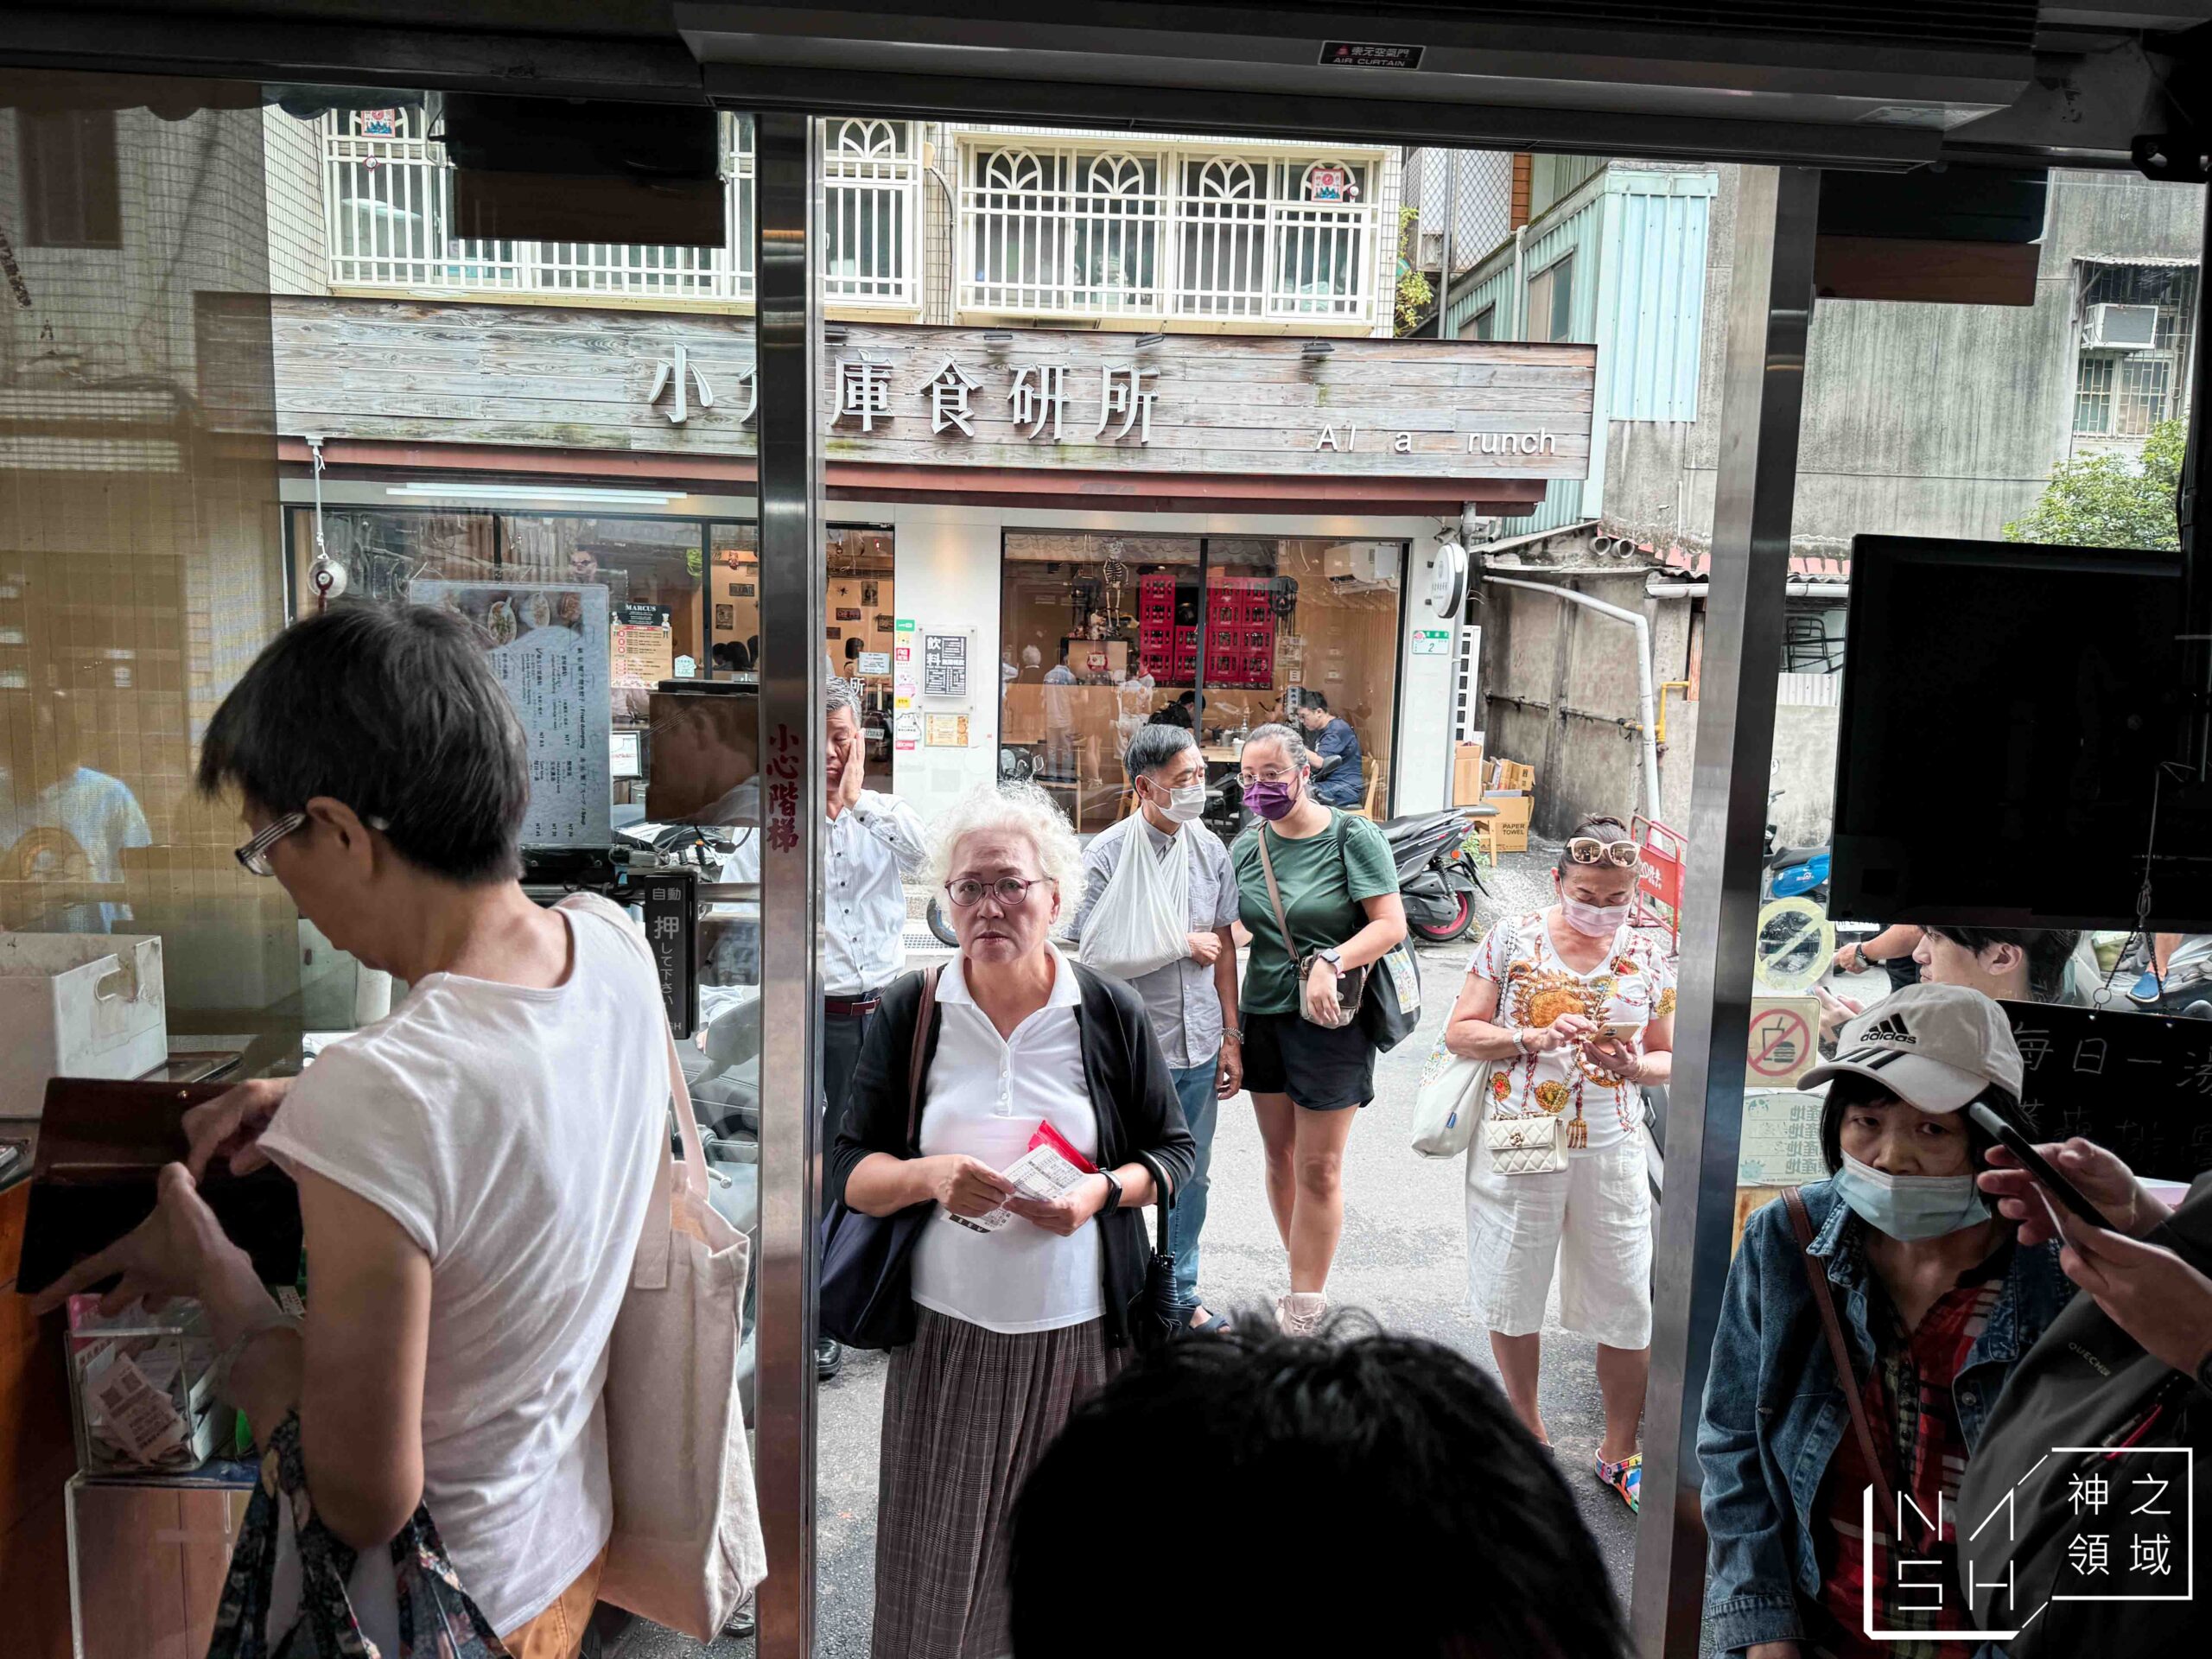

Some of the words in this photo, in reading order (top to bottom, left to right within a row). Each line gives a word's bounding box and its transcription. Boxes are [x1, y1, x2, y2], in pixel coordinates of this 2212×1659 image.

[1357, 58, 1406, 67] CURTAIN
[1394, 431, 1413, 453] a
[1468, 427, 1556, 454] runch
[926, 636, 941, 666] 飲料
[1428, 642, 1434, 652] 2
[849, 677, 865, 696] 所
[766, 723, 799, 854] 小心階梯
[652, 887, 682, 900] 自動
[1860, 1031, 1916, 1045] adidas
